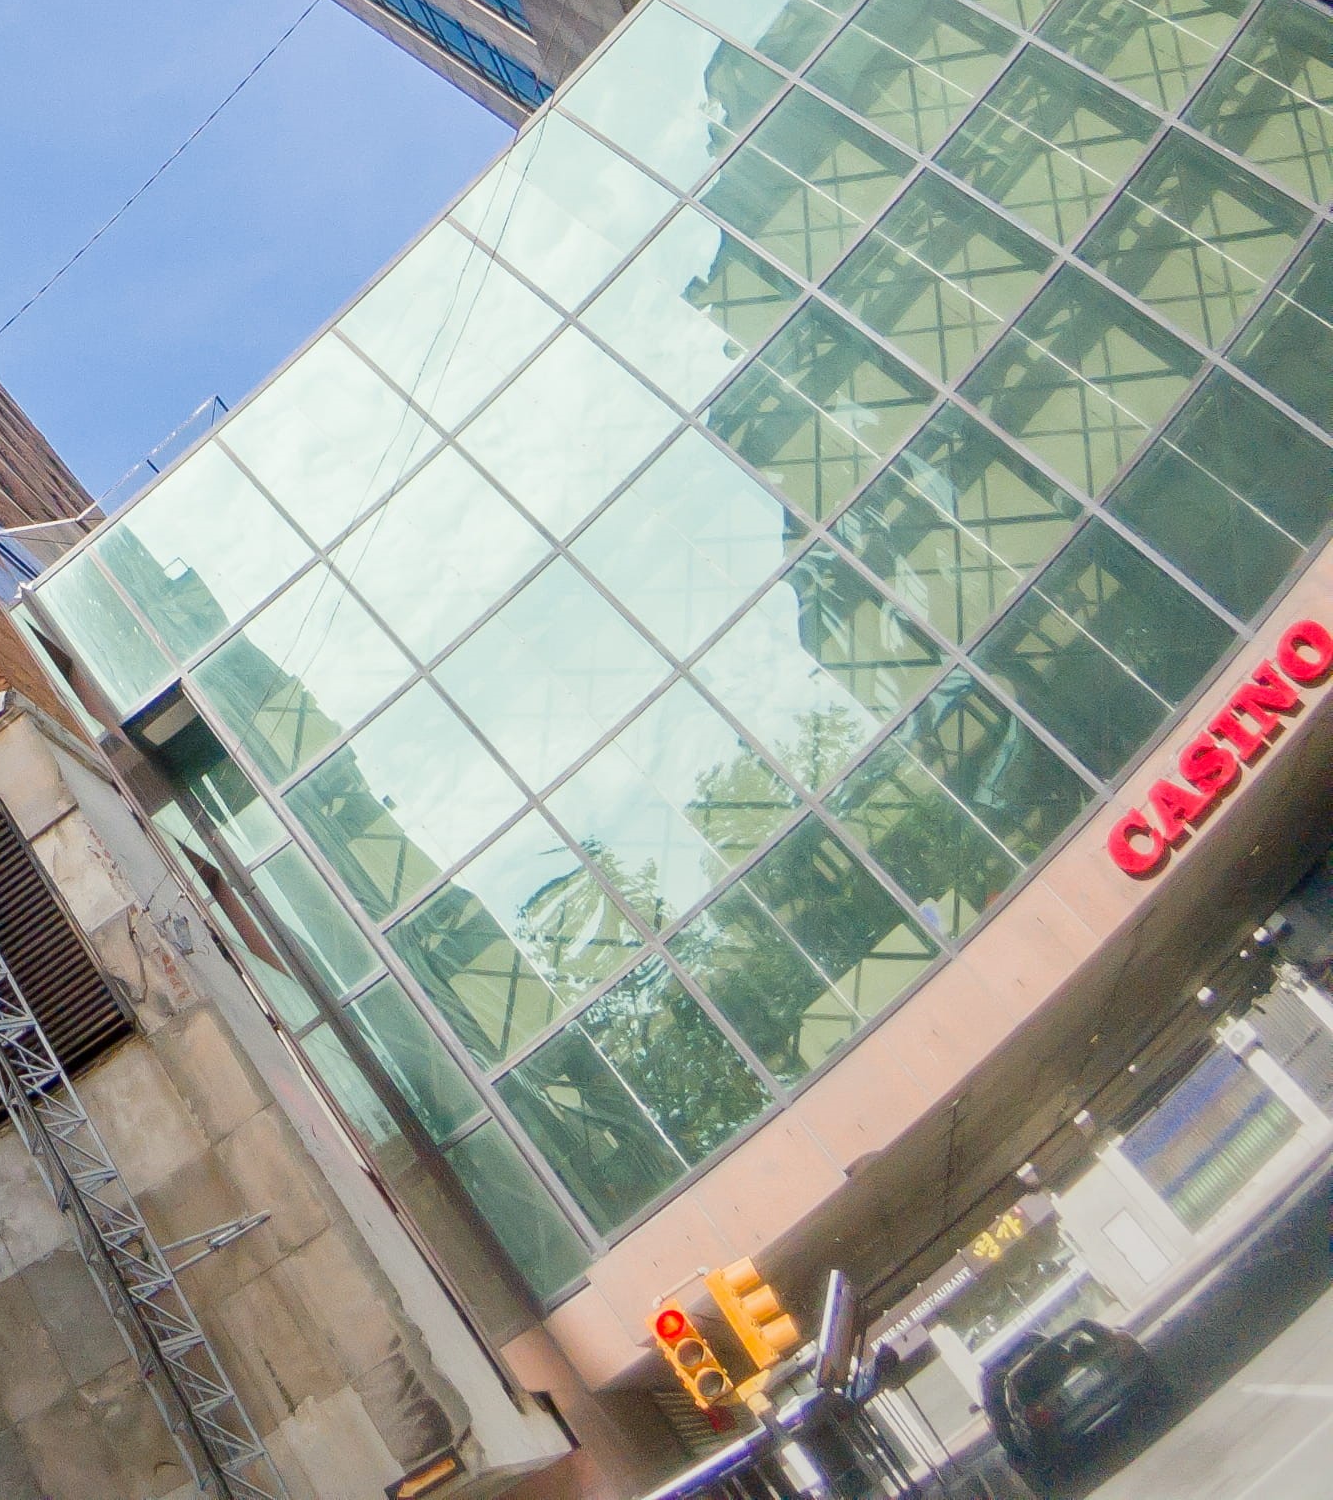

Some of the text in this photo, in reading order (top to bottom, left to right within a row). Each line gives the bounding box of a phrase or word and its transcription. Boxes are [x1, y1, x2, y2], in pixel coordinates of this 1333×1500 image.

[1107, 619, 1333, 873] CASINO
[870, 1265, 972, 1353] KOREAN RESTAURANT
